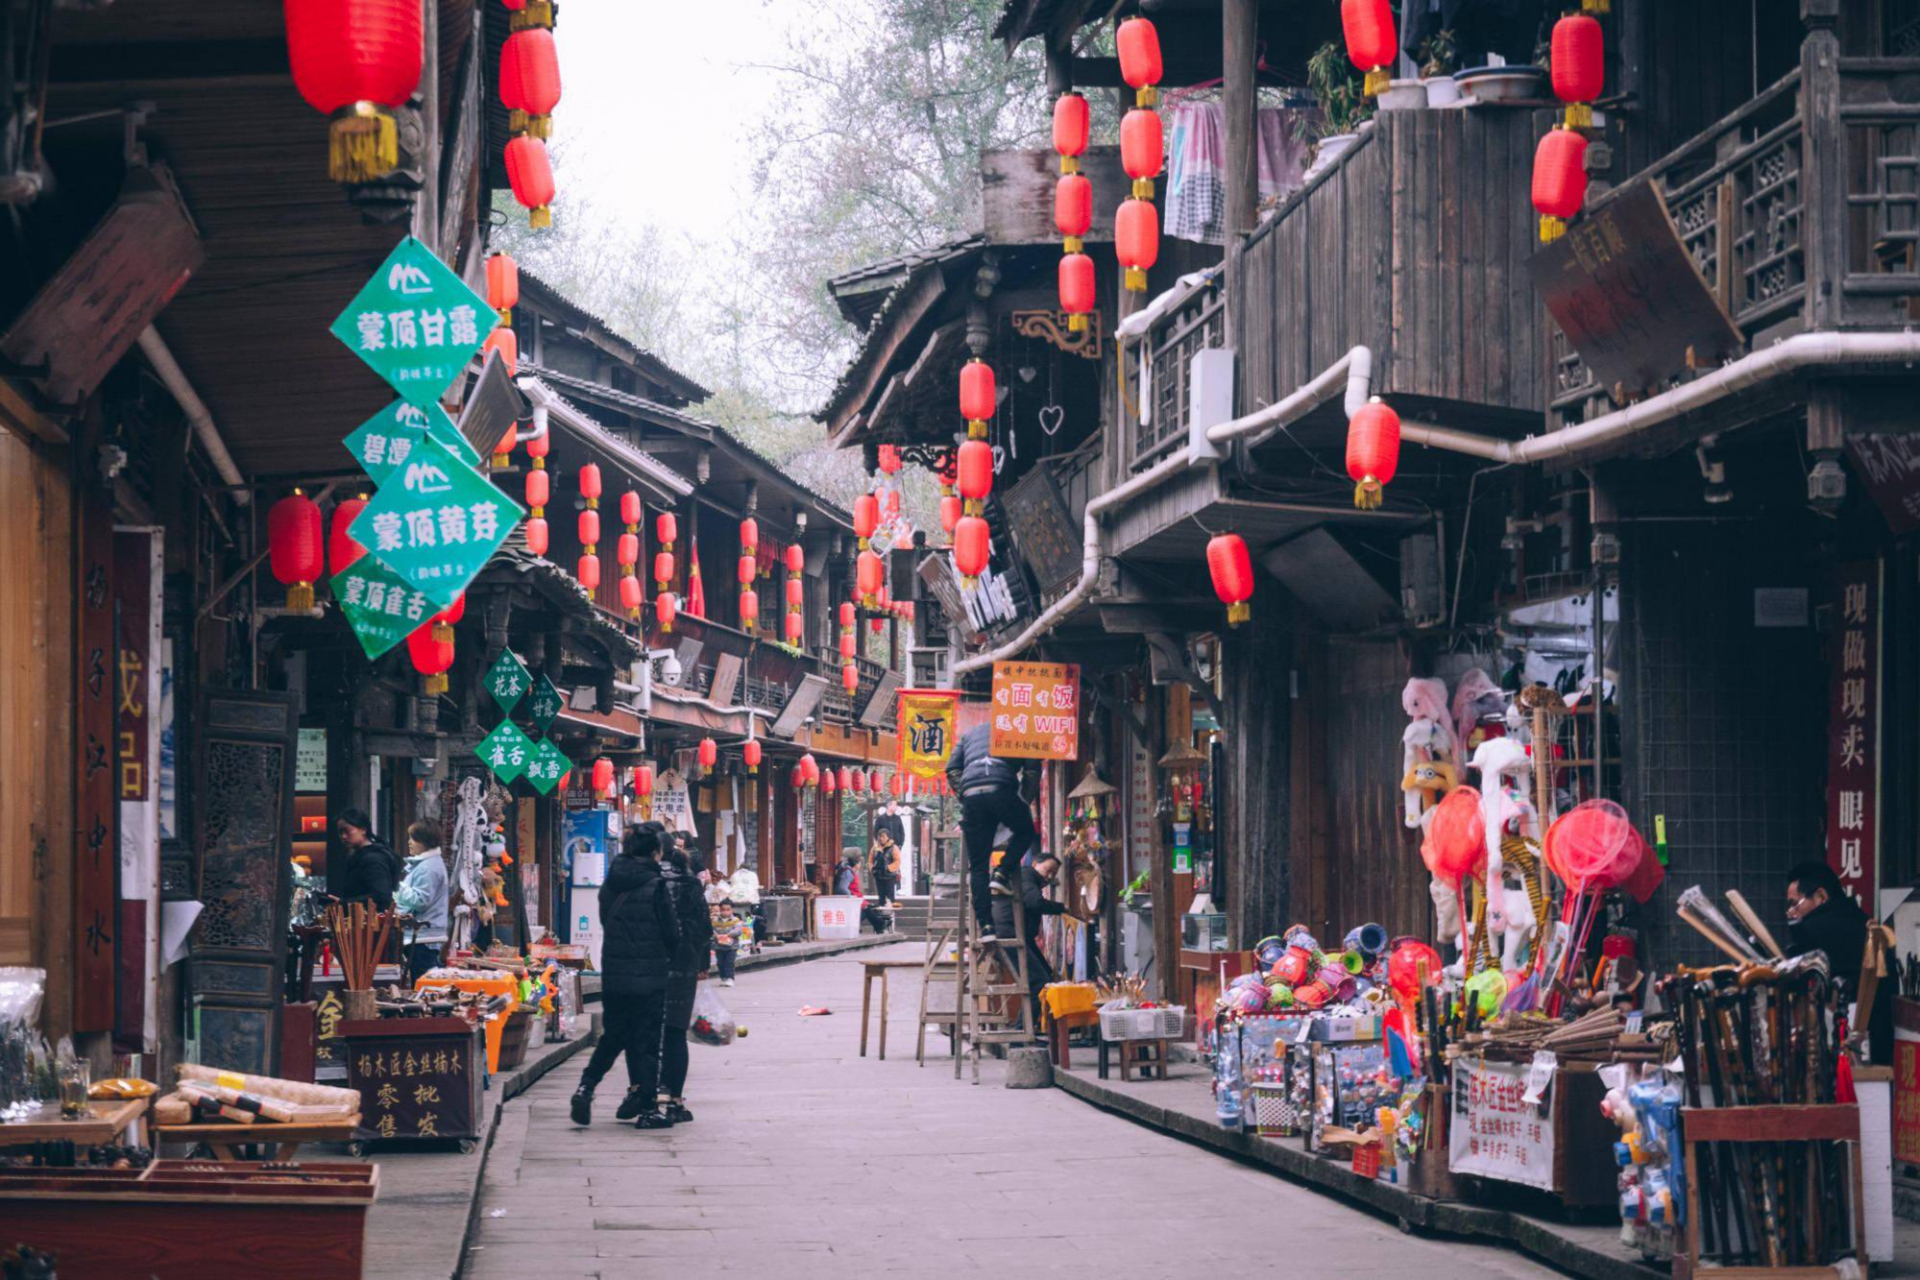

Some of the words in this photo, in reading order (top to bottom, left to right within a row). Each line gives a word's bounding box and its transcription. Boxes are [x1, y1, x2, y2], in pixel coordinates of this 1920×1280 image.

[357, 304, 478, 351] 蒙顶甘露
[372, 501, 499, 552] 蒙顶黄芽
[344, 576, 426, 621] 蒙顶雀舌
[494, 675, 522, 696] 花茶
[1839, 583, 1867, 770] 现做现卖
[996, 684, 1074, 709] 有面有饭
[909, 713, 945, 756] 酒
[996, 713, 1029, 734] 还有
[1033, 715, 1075, 734] WIFI
[488, 744, 526, 768] 雀舌
[528, 760, 560, 779] 飘雪
